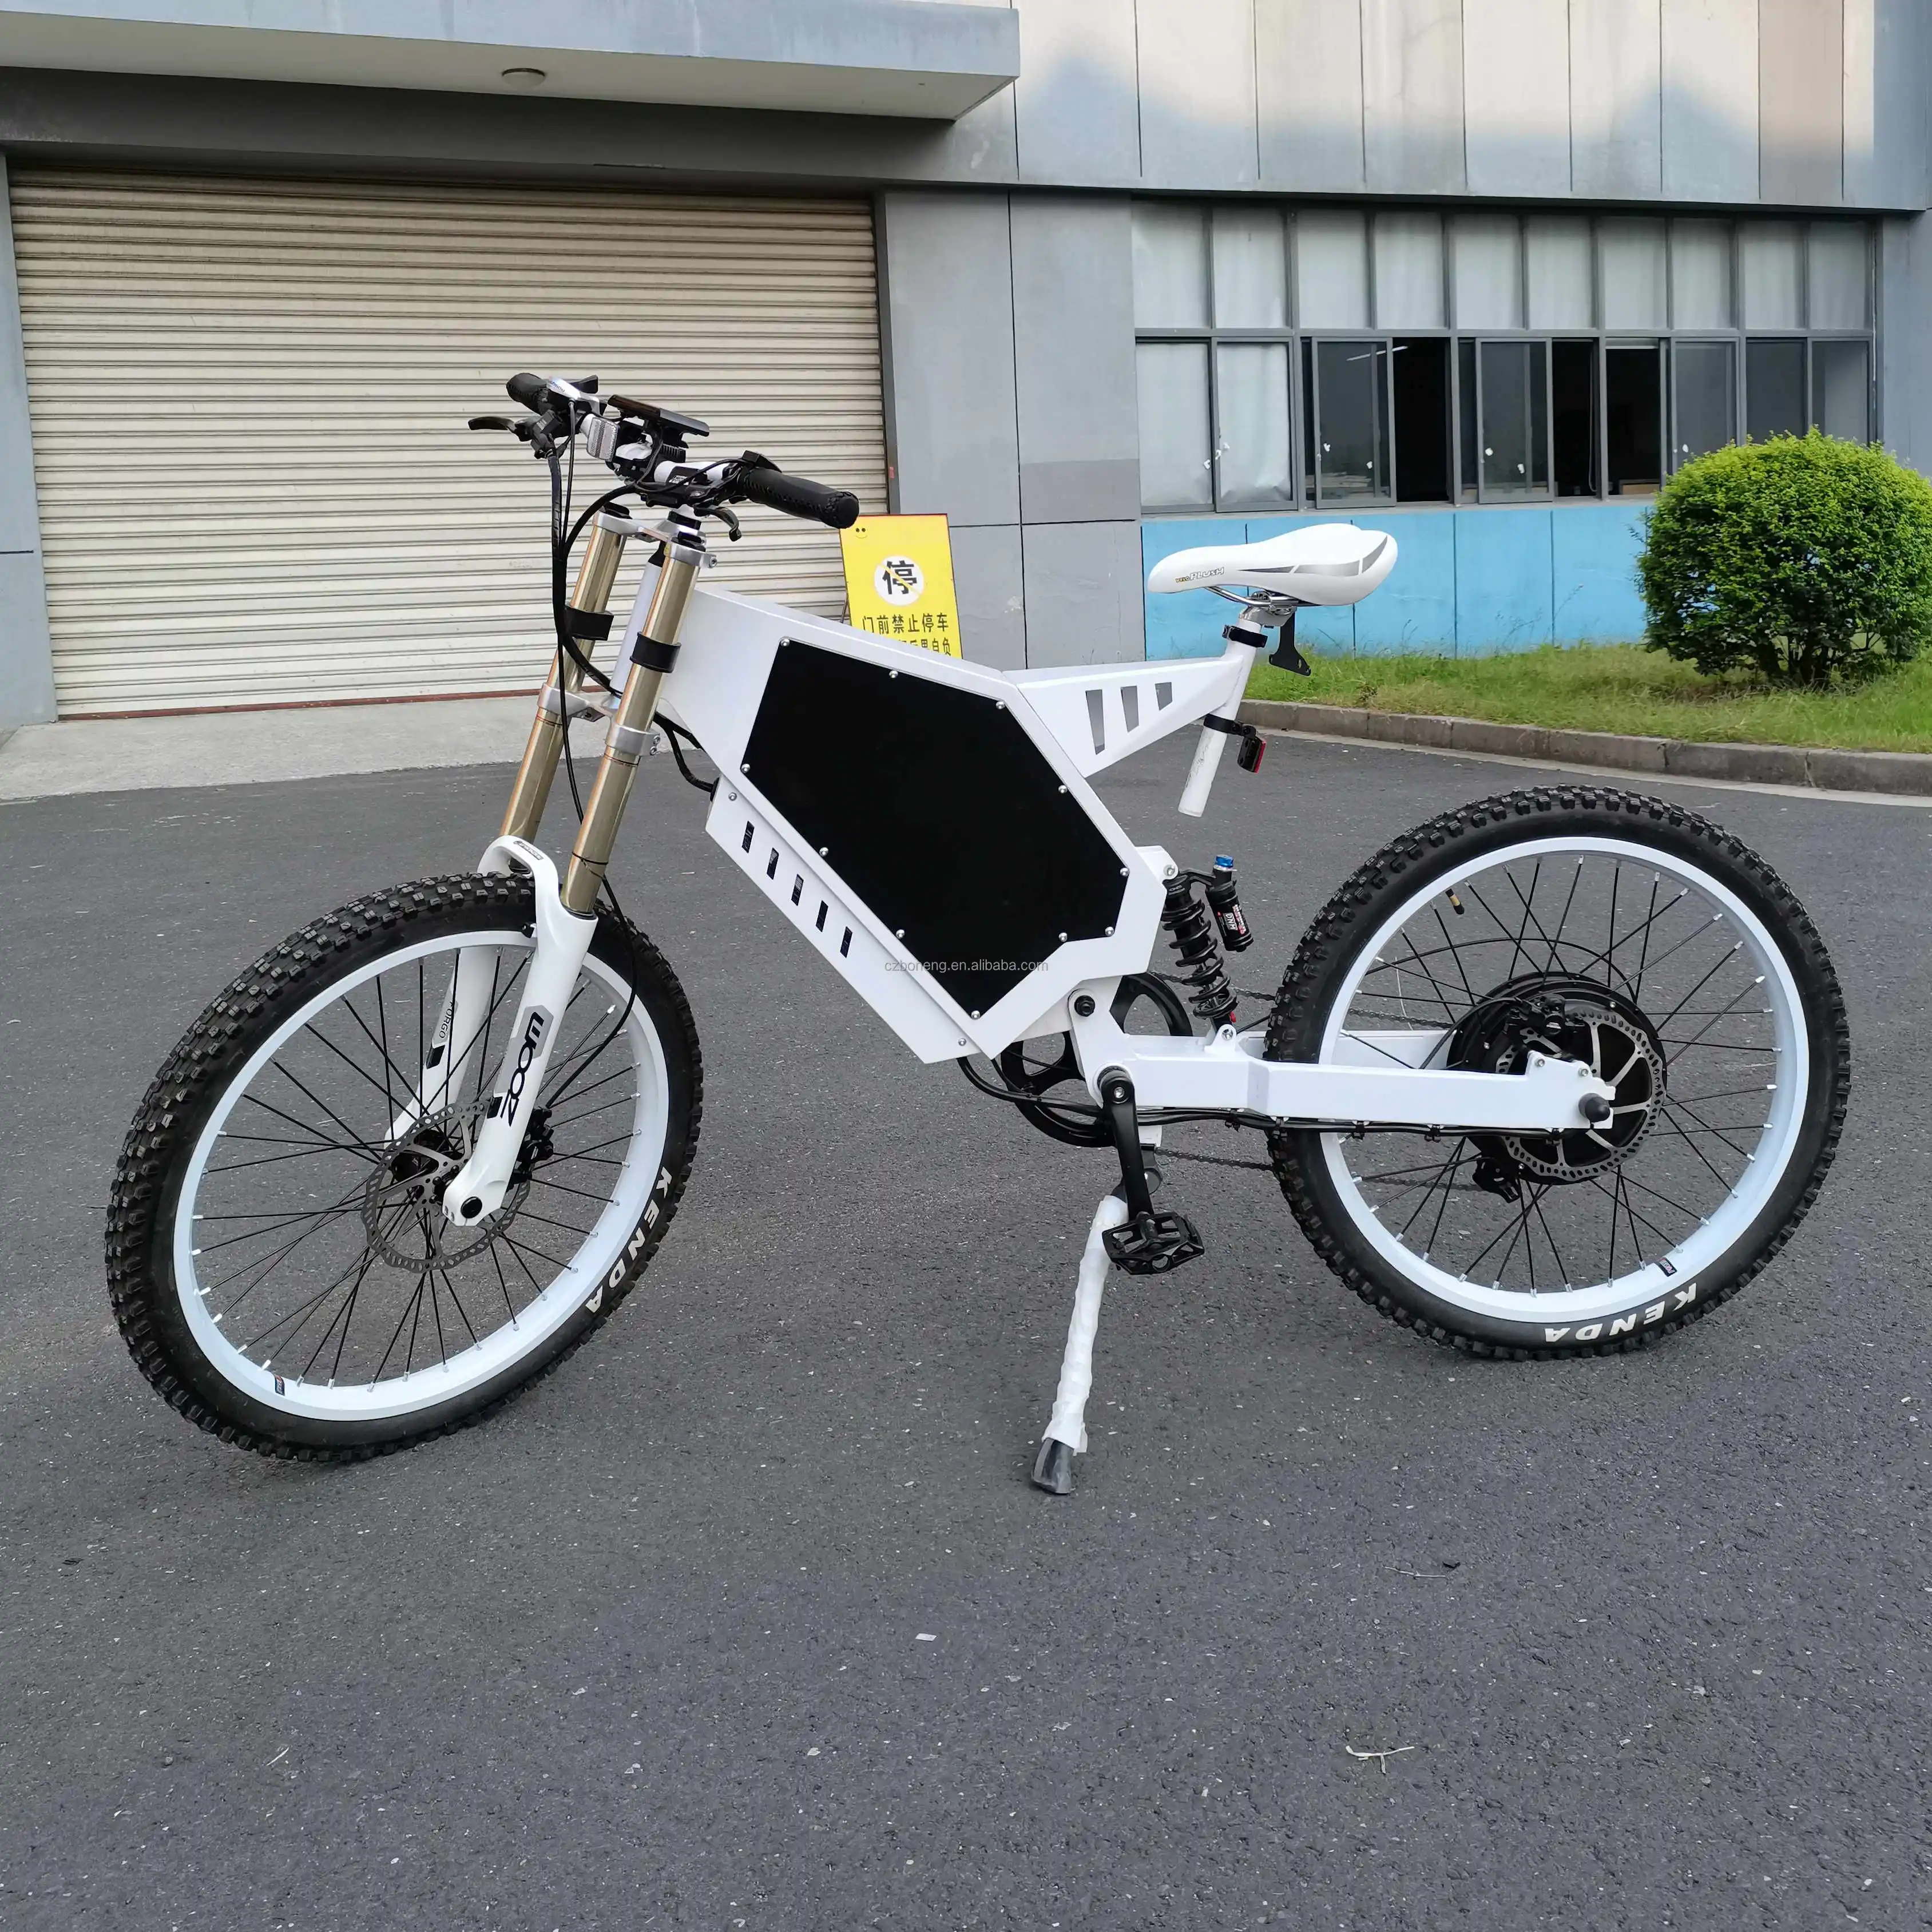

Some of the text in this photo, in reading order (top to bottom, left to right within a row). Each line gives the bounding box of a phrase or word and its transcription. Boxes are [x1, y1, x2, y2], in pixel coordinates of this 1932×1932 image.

[882, 560, 917, 595] 停
[1190, 566, 1225, 581] PLUSH
[862, 613, 949, 634] 门前禁止停车
[585, 1166, 672, 1313] KENDA
[1545, 1283, 1696, 1342] KENDA
